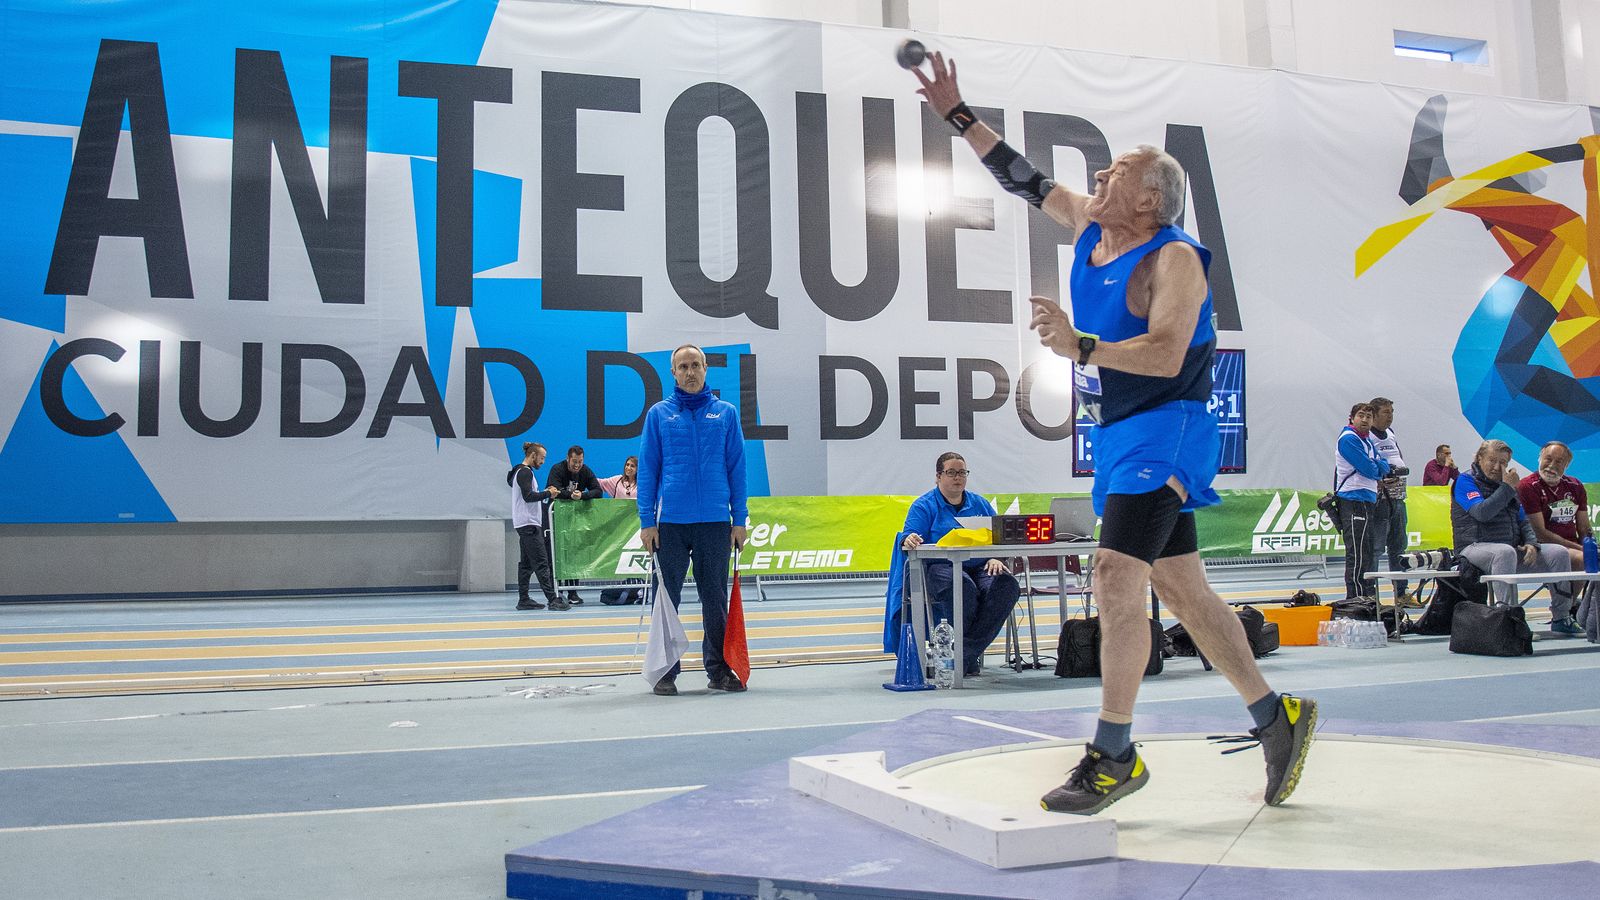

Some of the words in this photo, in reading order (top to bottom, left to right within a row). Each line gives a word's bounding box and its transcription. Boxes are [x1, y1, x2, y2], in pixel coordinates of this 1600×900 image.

[40, 338, 546, 439] CIUDAD
[586, 350, 789, 441] DL
[1559, 506, 1574, 516] 146
[1260, 536, 1302, 550] RFEA
